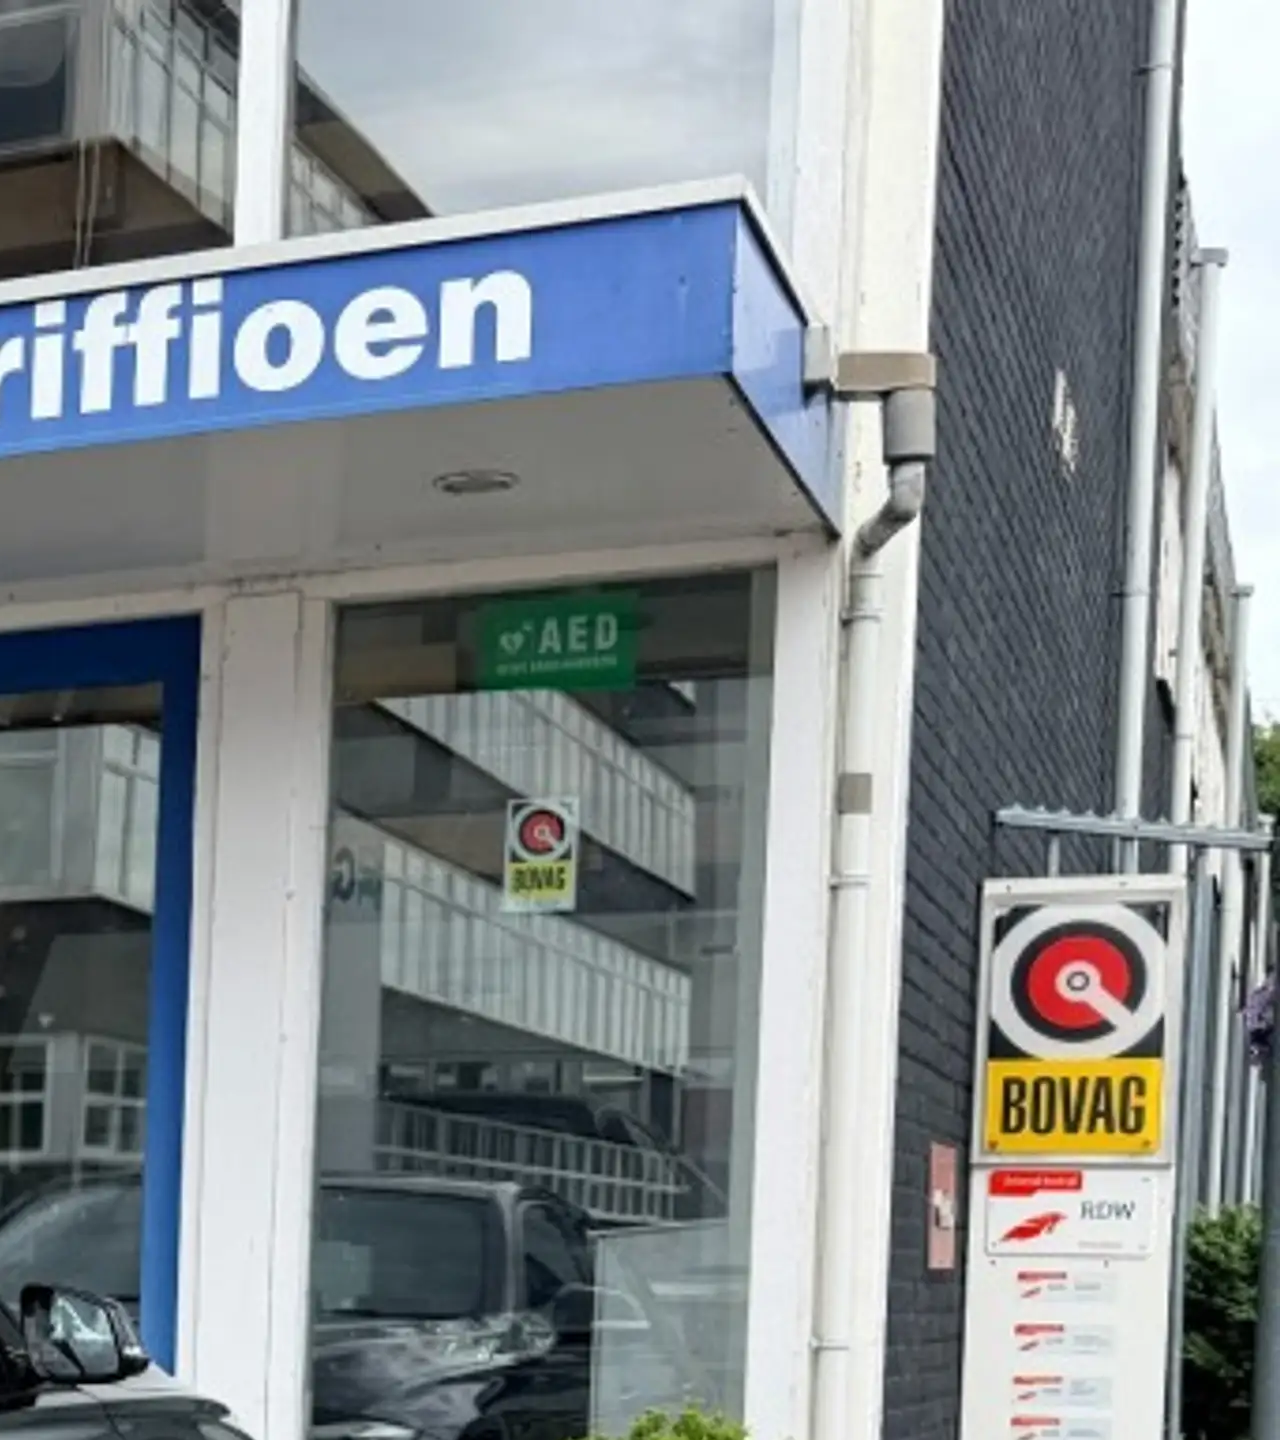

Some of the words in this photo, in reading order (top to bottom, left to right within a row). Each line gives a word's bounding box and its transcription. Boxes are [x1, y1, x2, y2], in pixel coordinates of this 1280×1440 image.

[538, 612, 618, 654] AED
[1000, 1075, 1148, 1135] BOVAG
[1080, 1200, 1136, 1220] RDW
